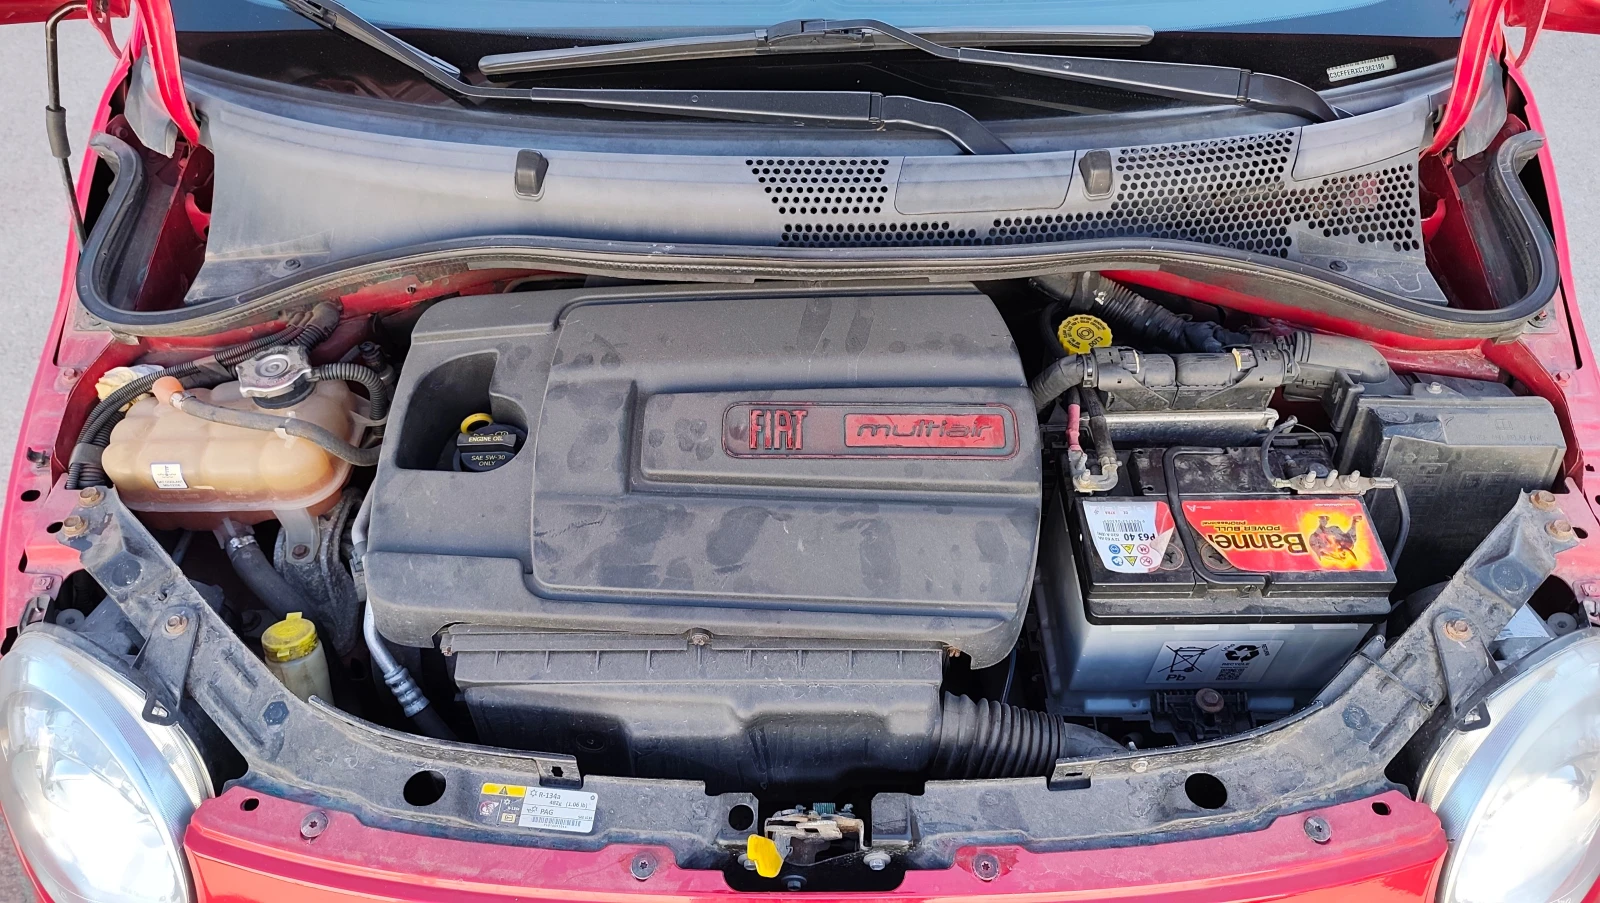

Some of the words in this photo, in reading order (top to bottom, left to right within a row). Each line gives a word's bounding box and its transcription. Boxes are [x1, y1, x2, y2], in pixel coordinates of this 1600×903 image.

[1088, 336, 1103, 347] DOT3
[749, 409, 808, 450] FIAT
[856, 418, 993, 439] multiair
[1123, 533, 1136, 541] 40
[538, 791, 561, 800] R-134a
[539, 808, 554, 816] PAG
